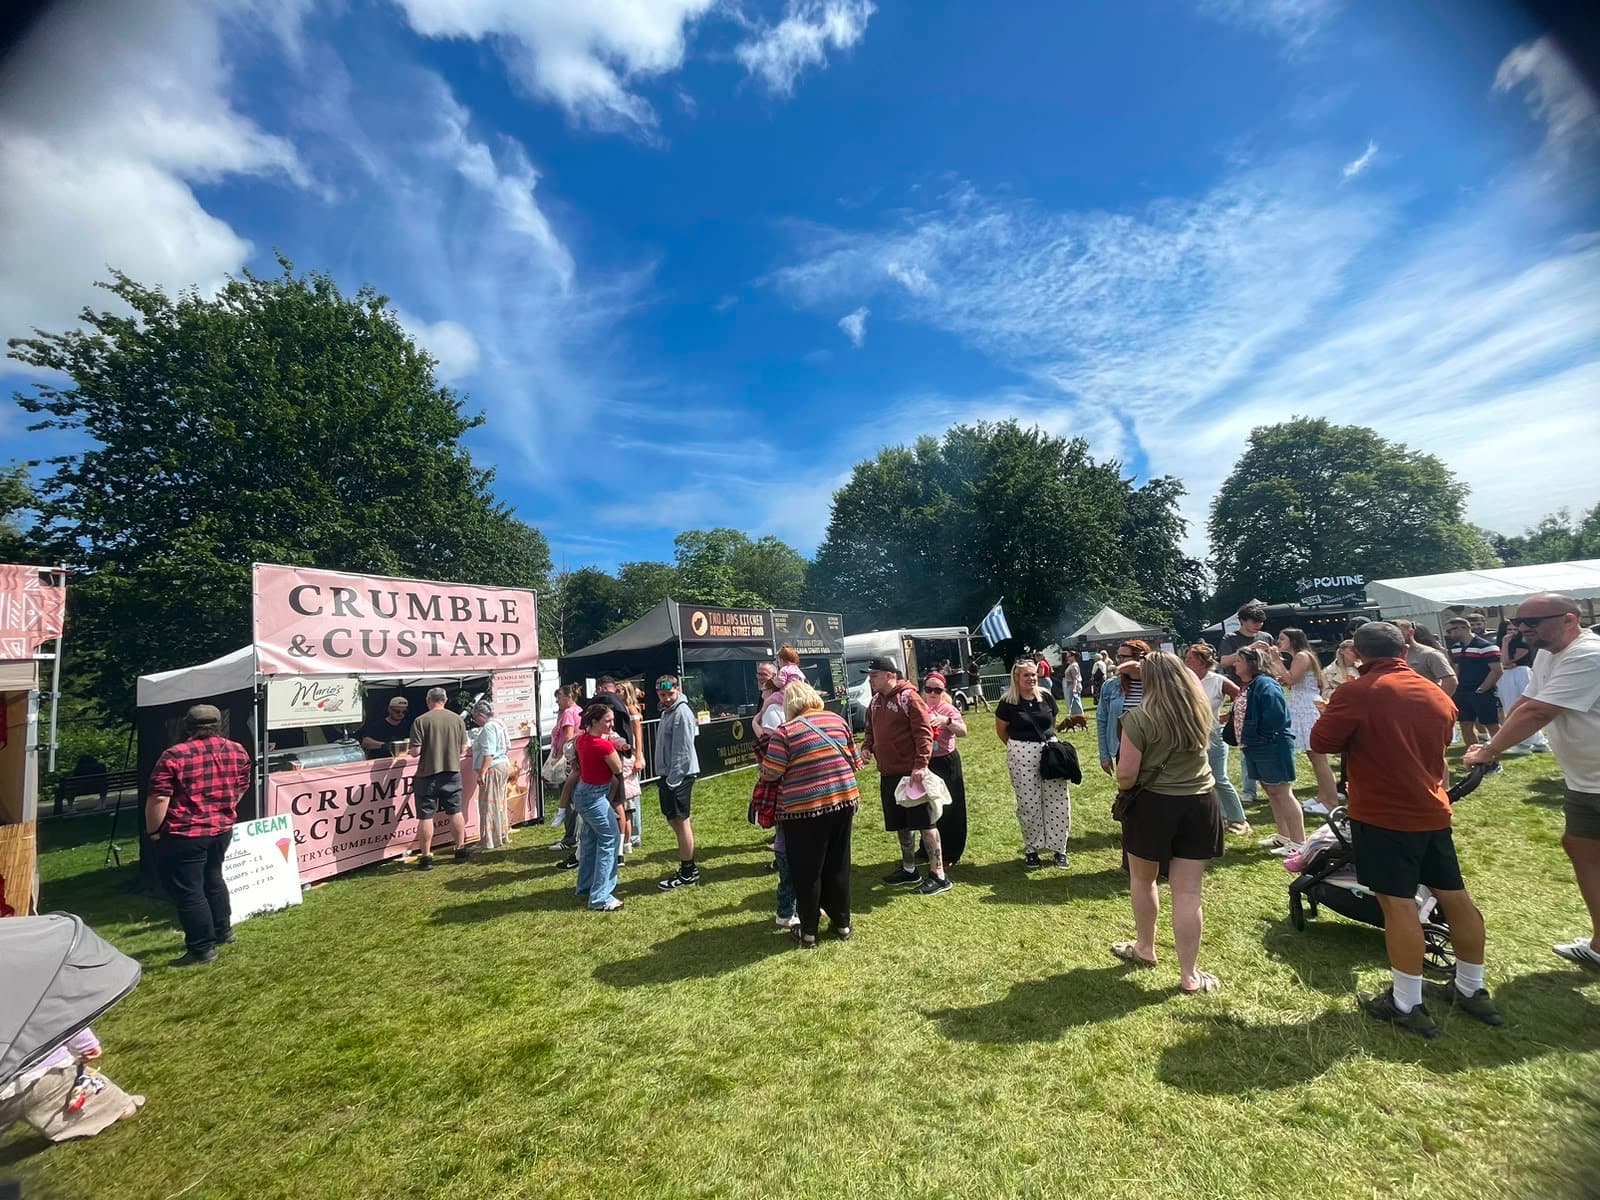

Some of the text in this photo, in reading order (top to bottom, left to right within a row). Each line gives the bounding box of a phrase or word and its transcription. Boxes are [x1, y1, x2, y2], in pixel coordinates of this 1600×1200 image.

[1313, 574, 1365, 588] POUTINE
[288, 584, 520, 624] CRUMBLE
[732, 626, 750, 637] STREET
[291, 775, 416, 816] CRUMB
[246, 815, 288, 837] CREAM
[229, 884, 250, 895] COOPS
